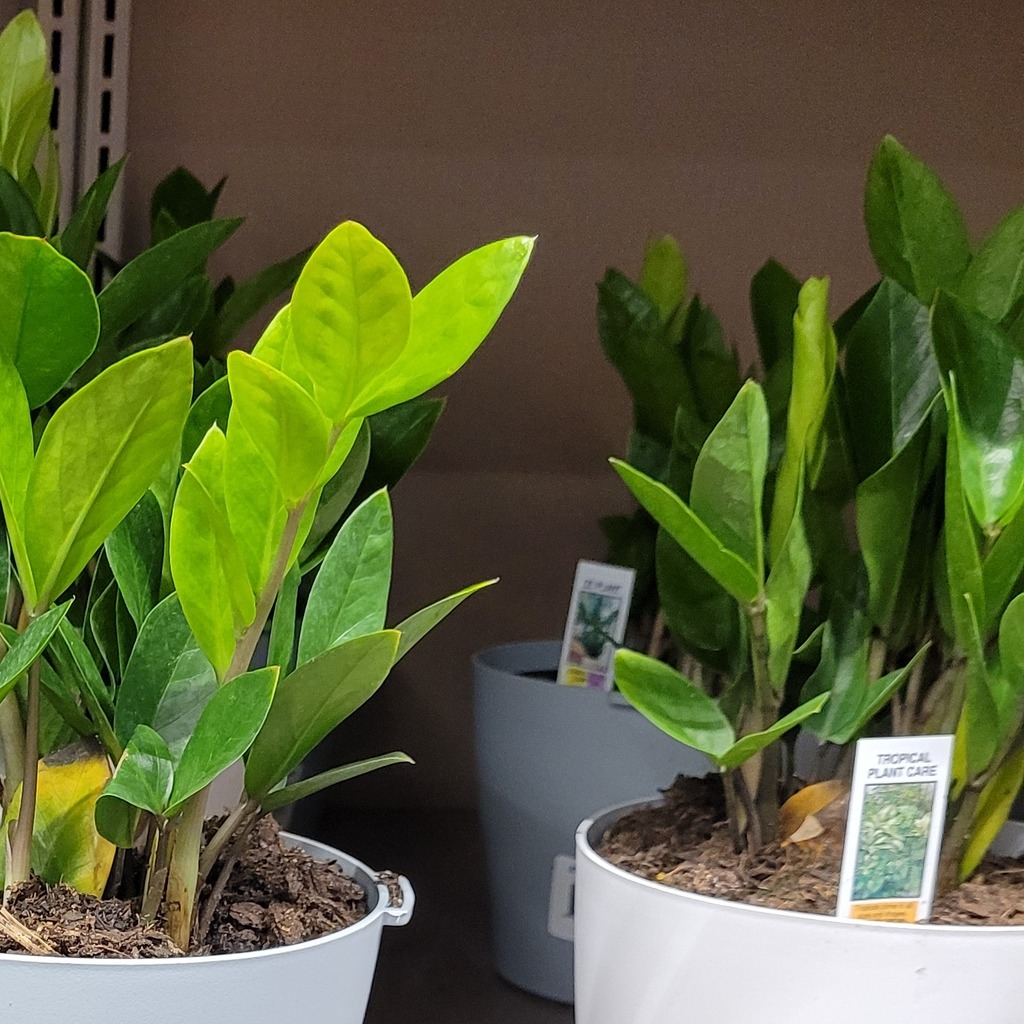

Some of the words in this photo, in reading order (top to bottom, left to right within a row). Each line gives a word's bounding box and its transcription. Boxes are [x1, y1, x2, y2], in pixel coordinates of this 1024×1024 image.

[876, 751, 931, 765] TROPICAL
[867, 766, 904, 779] PLANT
[906, 765, 938, 777] CARE
